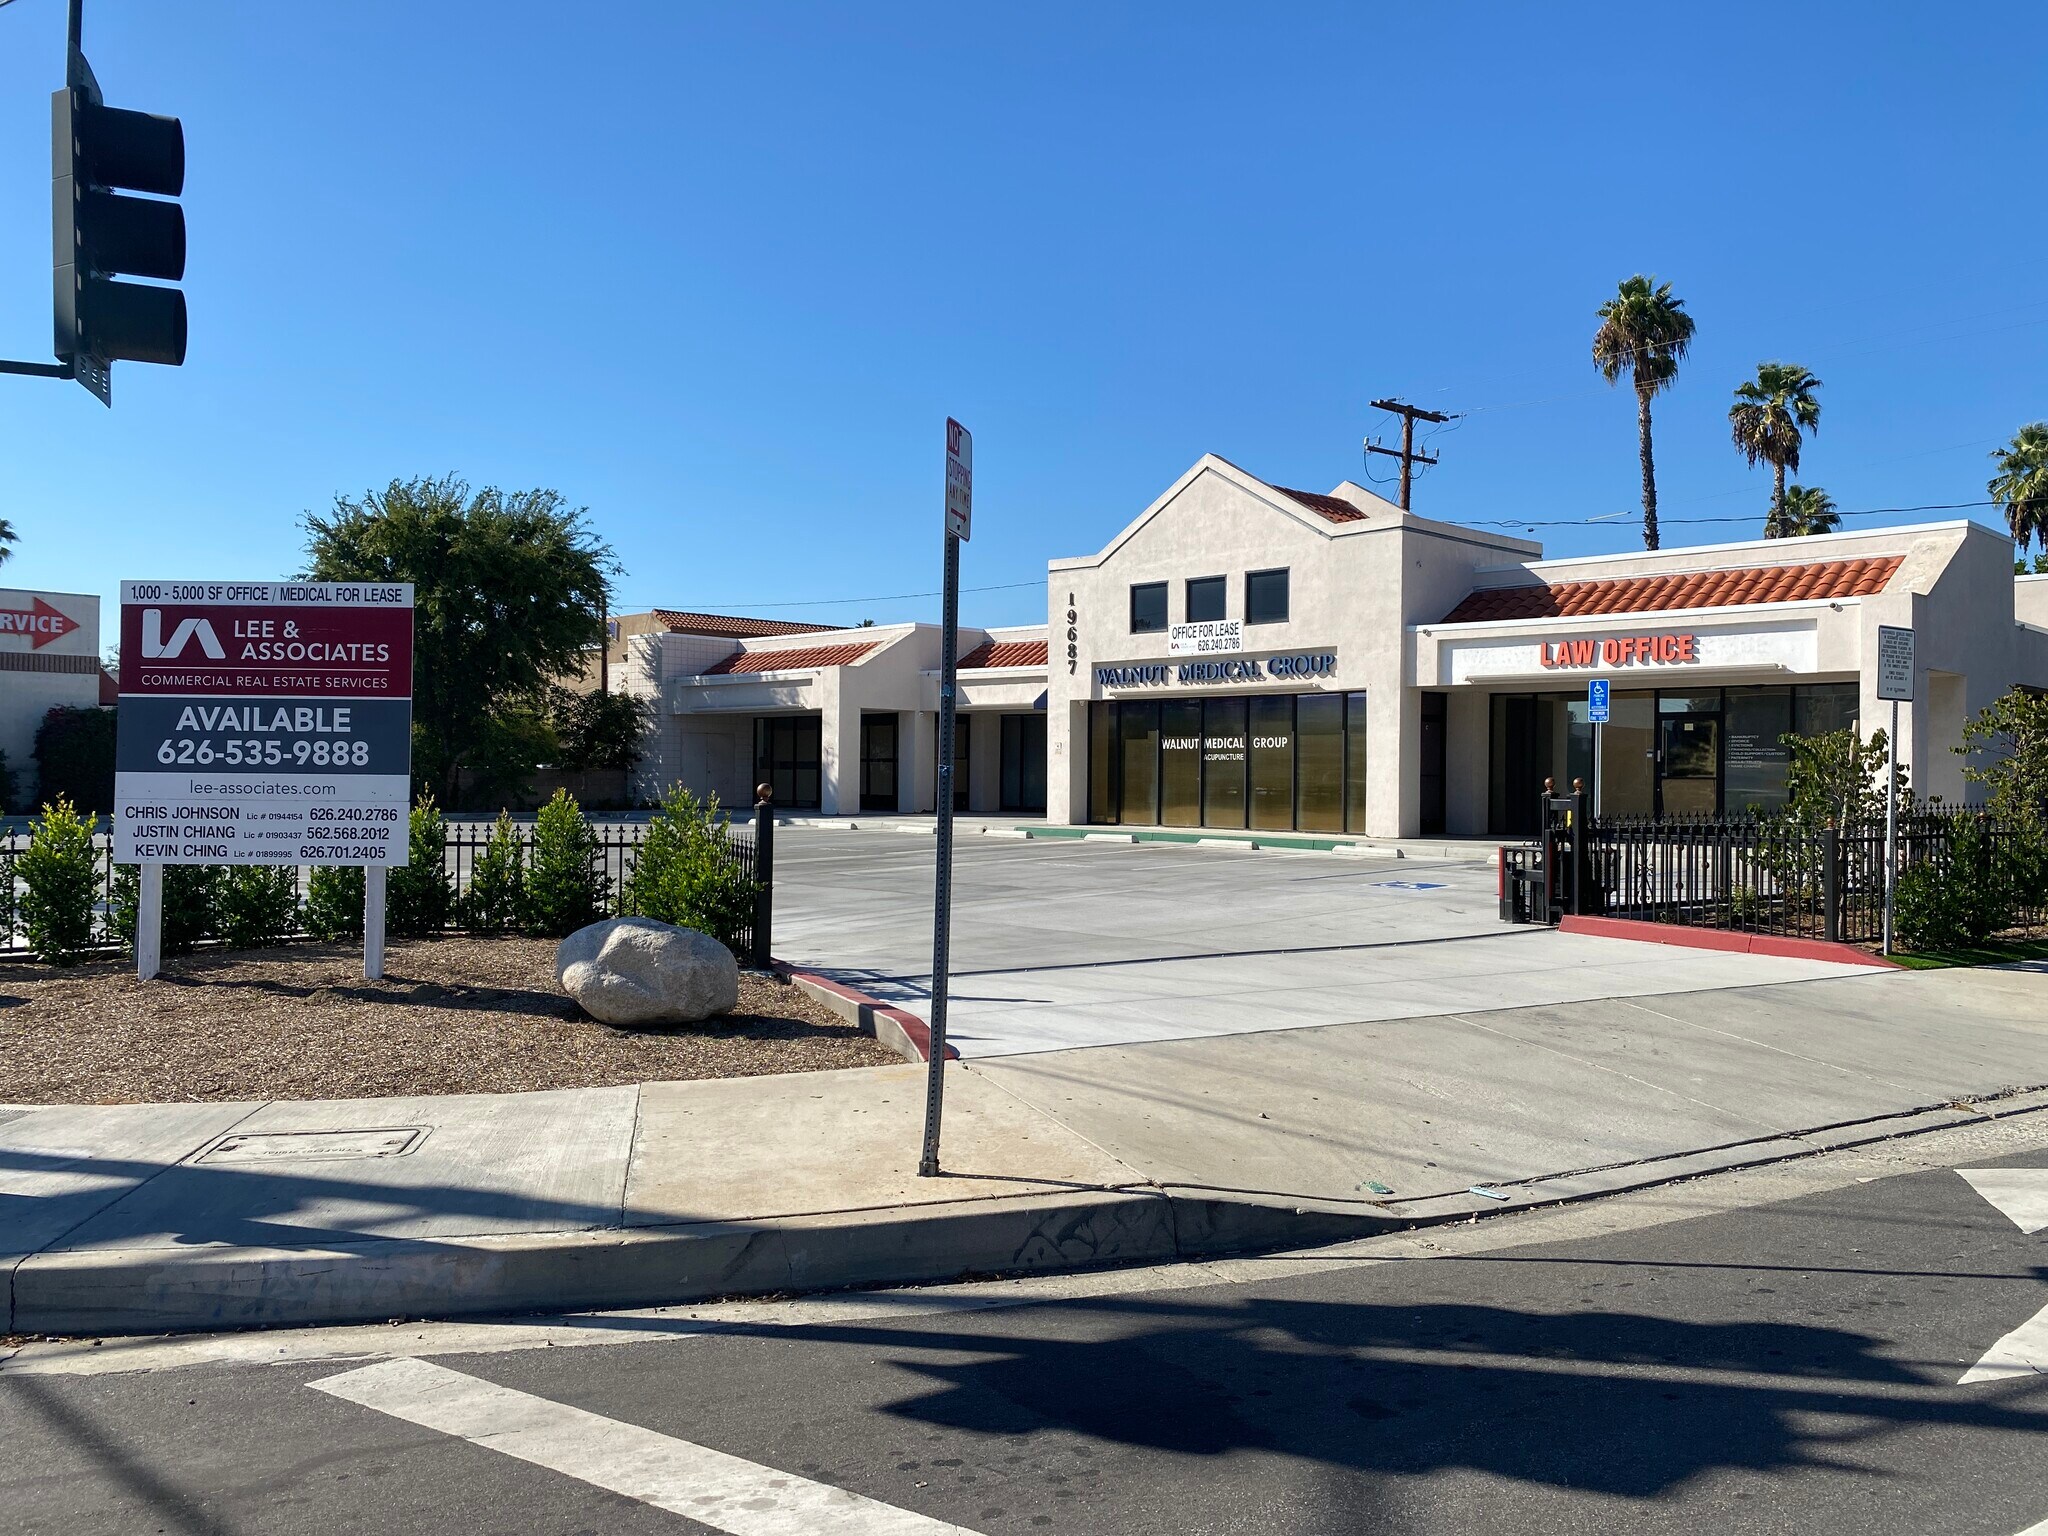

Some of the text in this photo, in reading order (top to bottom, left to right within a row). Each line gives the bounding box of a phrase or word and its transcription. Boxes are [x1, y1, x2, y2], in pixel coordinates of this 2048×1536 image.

[948, 422, 958, 451] NO
[948, 456, 971, 490] STOPPING
[949, 481, 970, 509] ANY TIME
[131, 585, 161, 602] 1,000
[172, 586, 204, 602] 5,000
[208, 586, 223, 600] SF
[226, 586, 268, 601] OFFICE
[272, 587, 277, 603] /
[280, 587, 332, 602] MEDICAL
[336, 588, 362, 602] FOR
[364, 588, 402, 602] LEASE
[234, 620, 300, 639] LEE &
[1172, 622, 1239, 640] OFFICE FOR LEASE
[240, 642, 389, 662] ASSOCIATES
[1198, 637, 1240, 651] 626.240.2786
[1540, 634, 1694, 666] LAW OFFICE
[1096, 654, 1336, 685] WALNUT MEDICAL GROUP
[142, 674, 388, 689] COMMERCIAL REAL ESTATE SERVICES
[175, 706, 351, 733] AVAILABLE
[1162, 736, 1288, 750] WALNUT MEDICAL GROUP
[157, 739, 370, 766] 626-535-9888
[1204, 752, 1245, 761] ACUPUNCTURE
[190, 779, 336, 796] lee-associates.com
[125, 806, 398, 822] CHRIS JOHNSON Lic # 01944154 626.240.2786
[132, 825, 179, 839] JUSTIN
[183, 826, 236, 839] CHIANG
[244, 831, 256, 839] Lic
[266, 832, 302, 840] 01903437
[306, 827, 390, 840] 562.568.2012
[135, 844, 178, 857] KEVIN
[182, 844, 228, 858] CHING
[234, 850, 245, 858] Lic
[256, 850, 292, 858] 01899995
[300, 845, 386, 860] 626.701.2405
